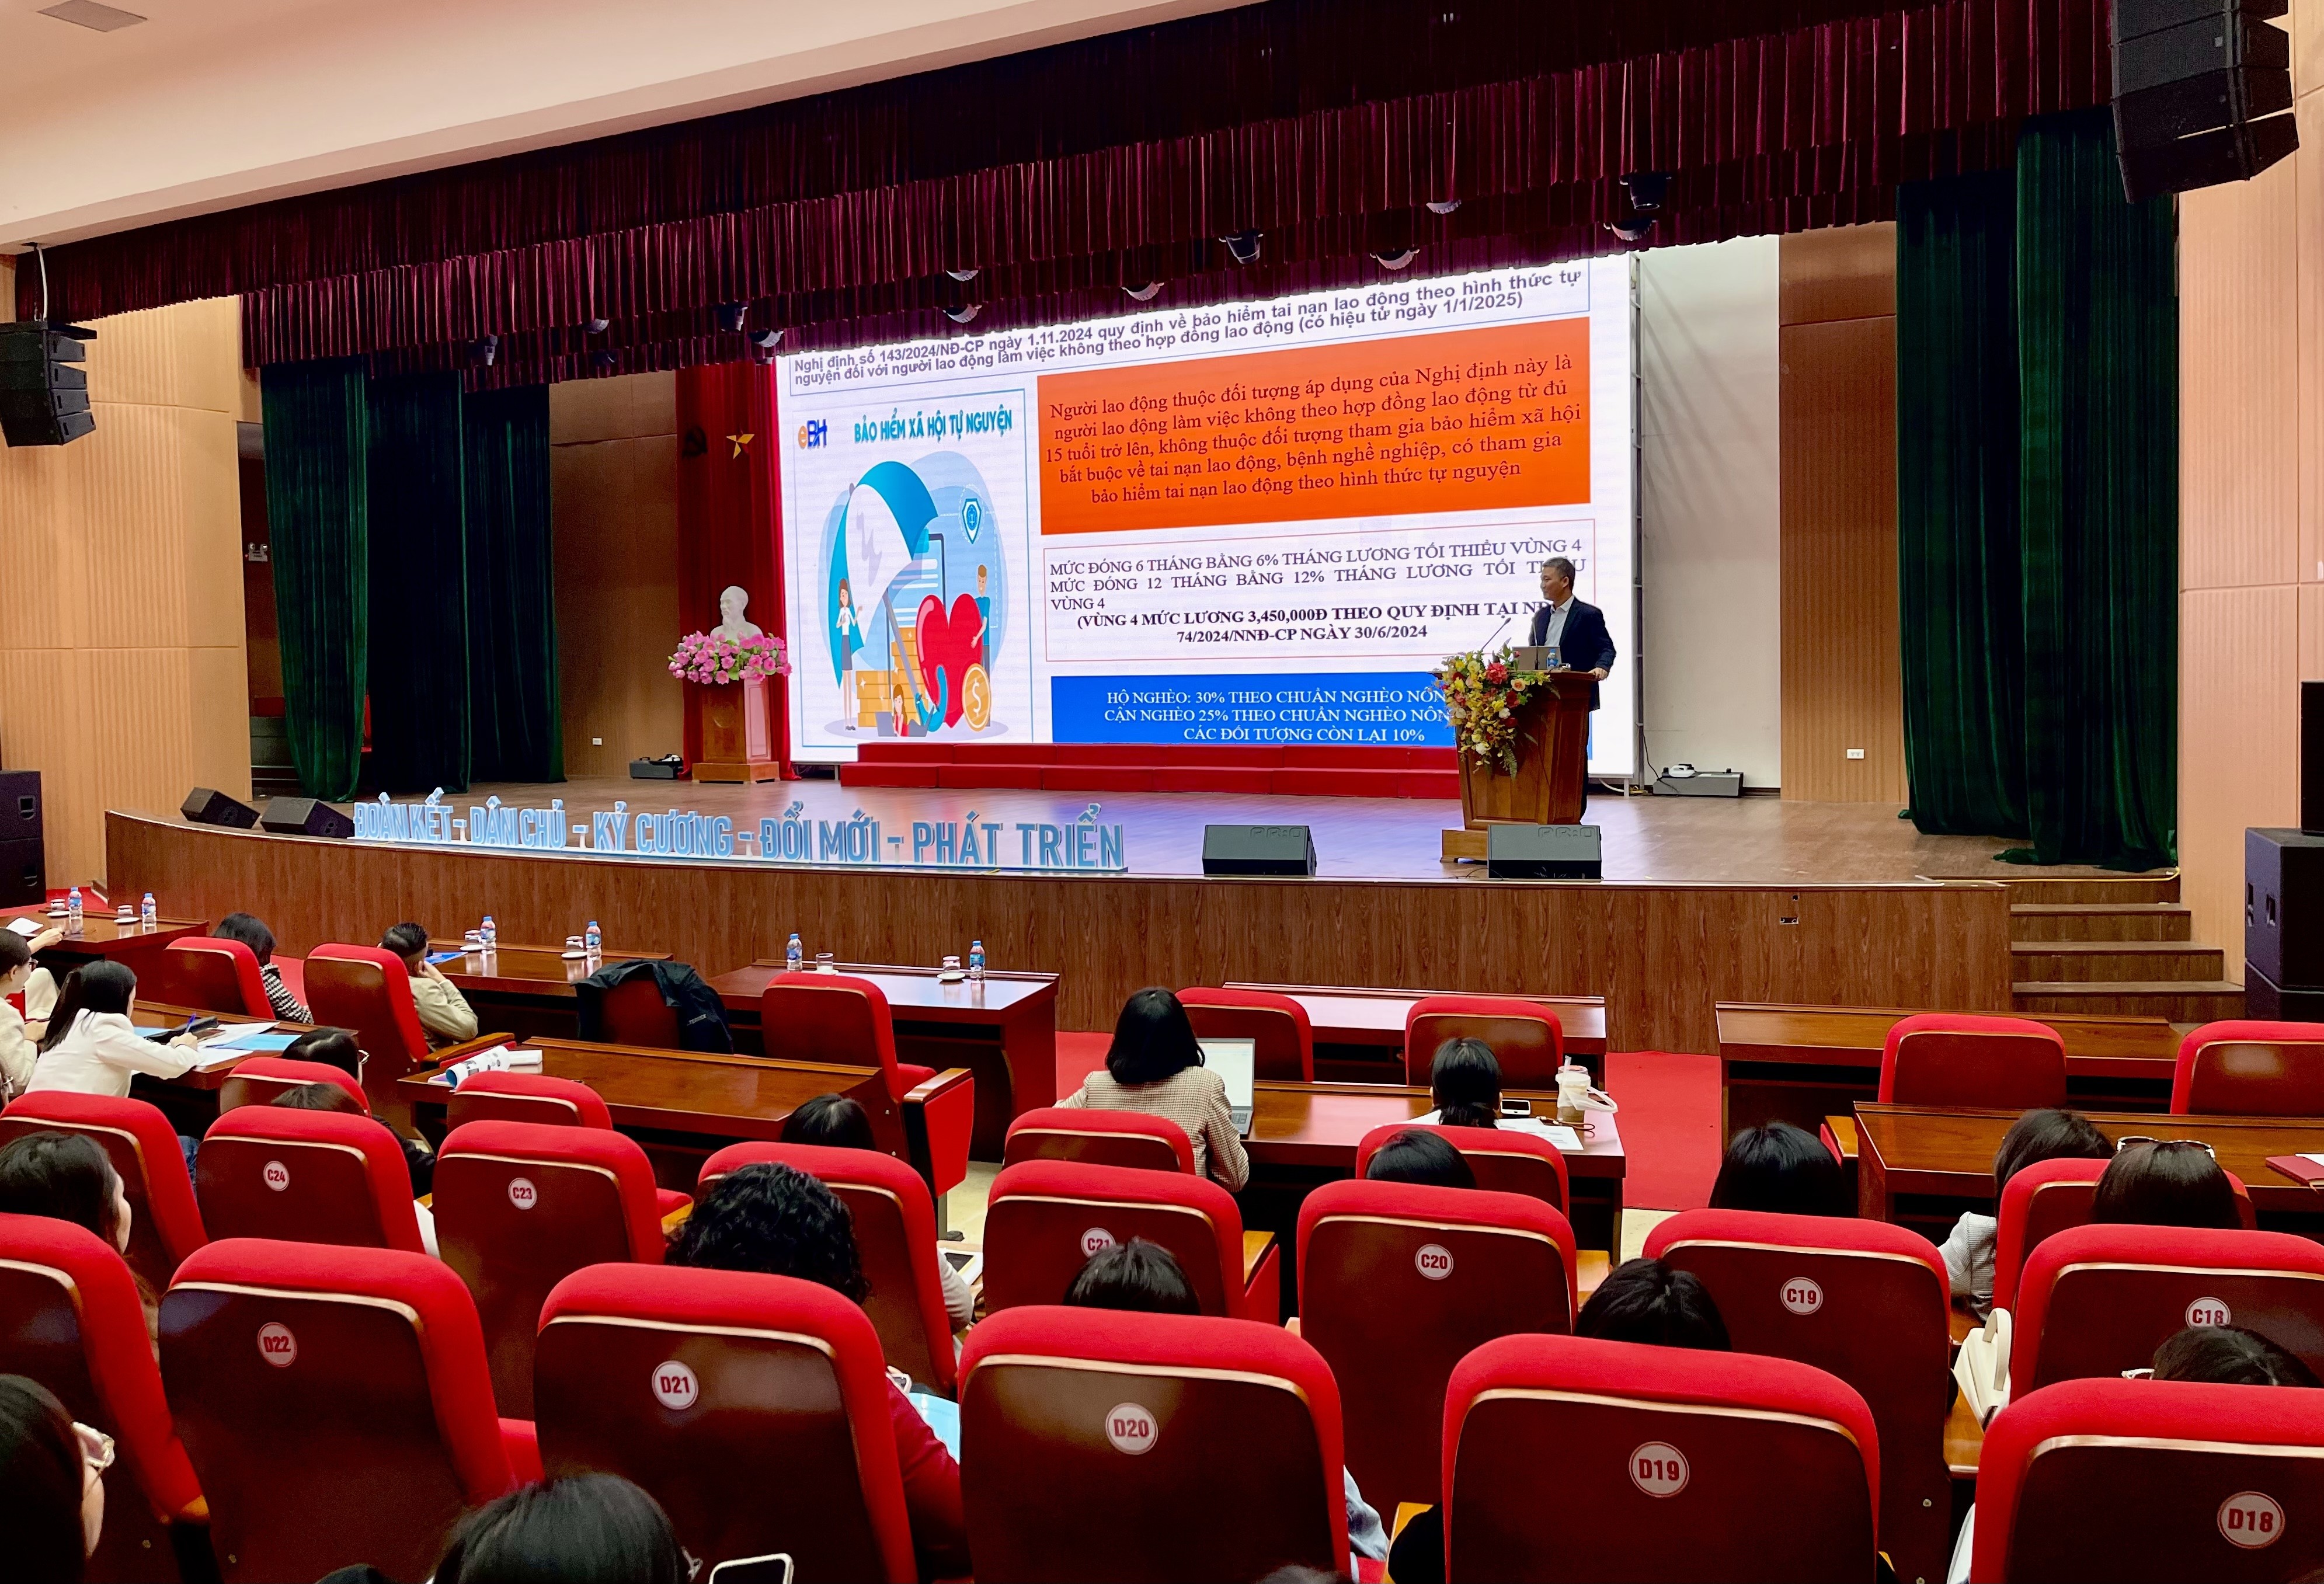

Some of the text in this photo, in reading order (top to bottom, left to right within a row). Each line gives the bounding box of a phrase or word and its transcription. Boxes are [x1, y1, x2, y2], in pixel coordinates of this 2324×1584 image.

[794, 271, 1582, 374] Nghị định số 143/2024/NĐ-CP ngày 1.11.2024 quy định về bảo hiểm tai nạn lao động theo hình thức tự
[1050, 355, 1572, 421] Người lao động thuộc đối tượng áp dụng của Nghị định này là
[1054, 380, 1568, 443] người lao động làm việc không theo hợp đồng lao động từ đủ
[854, 404, 1013, 443] BẢO HIỂM XÃ HỘI TỰ NGUYỆN
[1046, 403, 1582, 463] 15 tuổi trở lên, không thuộc đối tượng tham gia bảo hiểm xã hội
[1092, 460, 1522, 504] bảo hiểm tai nạn lao động theo hình thức tự nguyện
[1049, 537, 1582, 576] MỨC ĐÓNG 6 THÁNG BẰNG 6% THÁNG LƯƠNG TỐI THIỂU VÙNG 4
[1050, 557, 1516, 593] MỨC ĐÓNG 12 THÁNG BẰNG 12% THÁNG LƯƠNG TỐI
[1050, 594, 1105, 611] VÙNG 4
[1077, 601, 1519, 631] (VÙNG 4 MỨC LƯƠNG 3,450,000Đ THEO QUY ĐỊNH TẠI
[1176, 624, 1428, 644] 74/2024/NNĐ-CP NGÀY 30/6/2024
[1107, 687, 1403, 708] HỘ NGHÈO: 30% THEO CHUẨN NGHÈO
[1104, 705, 1407, 726] CẬN NGHÈO 25% THEO CHUẨN NGHÈO
[1184, 725, 1425, 744] CÁC ĐỐI TƯỢNG CÒN LẠI 10%
[353, 786, 1124, 868] ĐOÀN KẾT DÂN CHỦ KỶ CƯƠNG ĐỔI MỚI PHÁT TRIỂN
[267, 1169, 286, 1182] C24
[513, 1186, 533, 1200] C23
[1421, 1254, 1448, 1269] C20
[1786, 1288, 1817, 1305] C19
[2192, 1308, 2225, 1327] C18
[263, 1335, 292, 1353] D22
[660, 1376, 690, 1394] D21
[1113, 1419, 1150, 1439] D20
[1638, 1457, 1680, 1481] D19
[2228, 1508, 2274, 1533] D18
